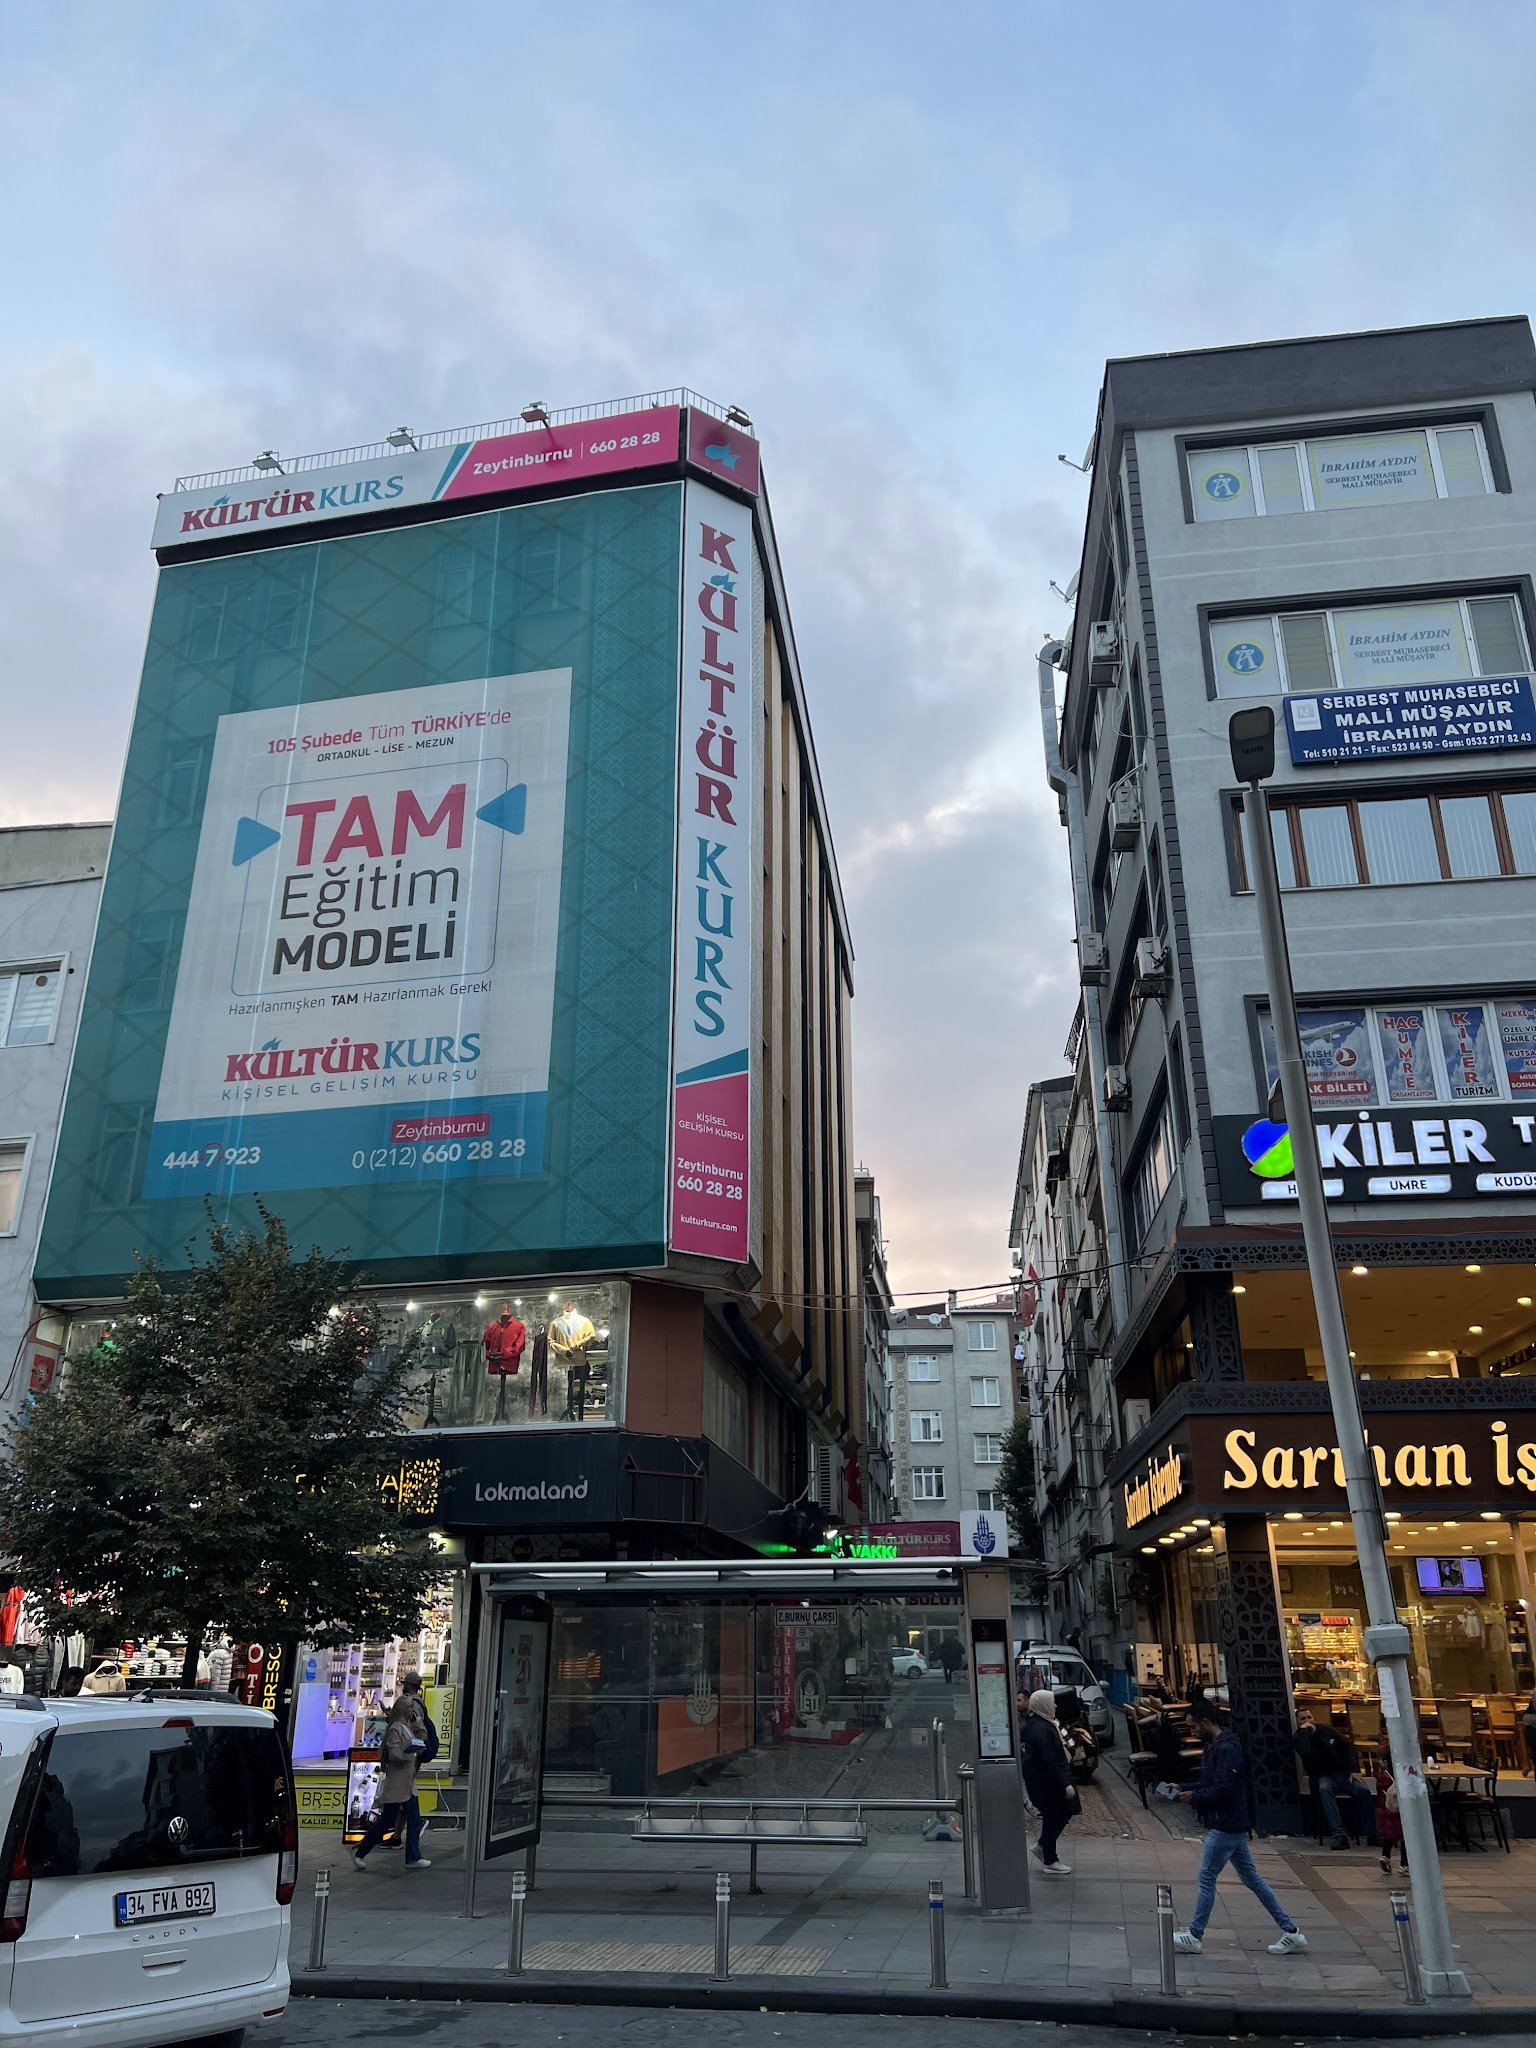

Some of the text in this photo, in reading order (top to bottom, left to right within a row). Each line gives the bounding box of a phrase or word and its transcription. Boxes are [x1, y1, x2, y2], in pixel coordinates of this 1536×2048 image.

[473, 430, 661, 477] Zeytinburnu 660 28 28
[1320, 455, 1418, 474] İBRAHİM AYDIN
[1325, 468, 1418, 485] SERBEST MUHASEBECİ
[1341, 477, 1404, 490] MALİ MÜŞAVİR
[1349, 628, 1451, 646] İBRAHİM AYDIN
[1353, 643, 1451, 660] SERBEST MUHASEBECİ
[1371, 652, 1436, 665] MALİ MÜŞAVİR
[1322, 679, 1521, 711] SERBEST MUHASEBECİ
[1335, 700, 1514, 727] MALİ MÜŞAVİR
[268, 738, 297, 754] 105
[301, 728, 363, 753] Şubede
[369, 721, 406, 741] Tüm
[1343, 719, 1513, 744] İBRAHİM AYDIN
[317, 747, 371, 762] ORTAOKUL
[382, 742, 405, 755] LİSE
[416, 736, 455, 750] MEZUN
[1303, 749, 1321, 759] Tel:
[1322, 748, 1339, 758] 510
[1341, 747, 1351, 756] 21
[1352, 745, 1363, 755] 21
[1371, 744, 1390, 754] Fax:
[1392, 742, 1406, 752] 523
[1407, 741, 1418, 751] 84
[1420, 740, 1433, 750] 50
[1442, 737, 1464, 749] Gsm:
[1466, 735, 1489, 746] 0532
[1490, 734, 1505, 745] 277
[1506, 733, 1519, 744] 82
[1520, 732, 1532, 743] 43
[285, 783, 467, 867] TAM
[280, 860, 459, 928] Eğitim
[272, 910, 457, 976] MODELİ
[694, 836, 734, 1037] KURS
[229, 980, 493, 1016] Hazırlanmışken TAM Hazırlanmak Gerek!
[1383, 1016, 1420, 1030] HAC
[1501, 1010, 1527, 1019] MEKKE
[1504, 1035, 1530, 1043] UMRE
[1525, 1024, 1536, 1032] VİZ
[1304, 1049, 1332, 1058] KISH
[1452, 1011, 1480, 1084] KİLER
[1508, 1049, 1536, 1057] KUTSA
[1398, 1032, 1416, 1089] UMRE
[1524, 1058, 1536, 1067] KÜ
[222, 1069, 478, 1101] KİŞİSEL GELİŞİM KURSU
[1326, 1080, 1368, 1093] BİLETİ
[1455, 1084, 1494, 1097] TURİZM
[1311, 1097, 1370, 1105] rturizm.com.tr
[395, 1119, 486, 1142] Zeytinburnu
[678, 1119, 744, 1141] GELİŞİM KURSU
[696, 1112, 728, 1127] KİŞİSEL
[1316, 1110, 1536, 1169] KİLER T
[163, 1146, 261, 1169] 444 7 923
[352, 1138, 526, 1172] 0 (212) 660 28 28
[677, 1157, 744, 1181] Zeytinburnu
[677, 1175, 743, 1201] 660 28 28
[1389, 1179, 1428, 1191] UMRE
[680, 1213, 738, 1234] kulturkurs.com
[475, 1479, 589, 1502] Lokmaland
[812, 1610, 836, 1624] ÇARŞI
[262, 1641, 283, 1710] BRESC
[515, 1658, 531, 1684] 20
[440, 1691, 453, 1739] BRESCIA
[128, 1888, 210, 1915] 34 FVA 892
[132, 1926, 199, 1942] CADDY
